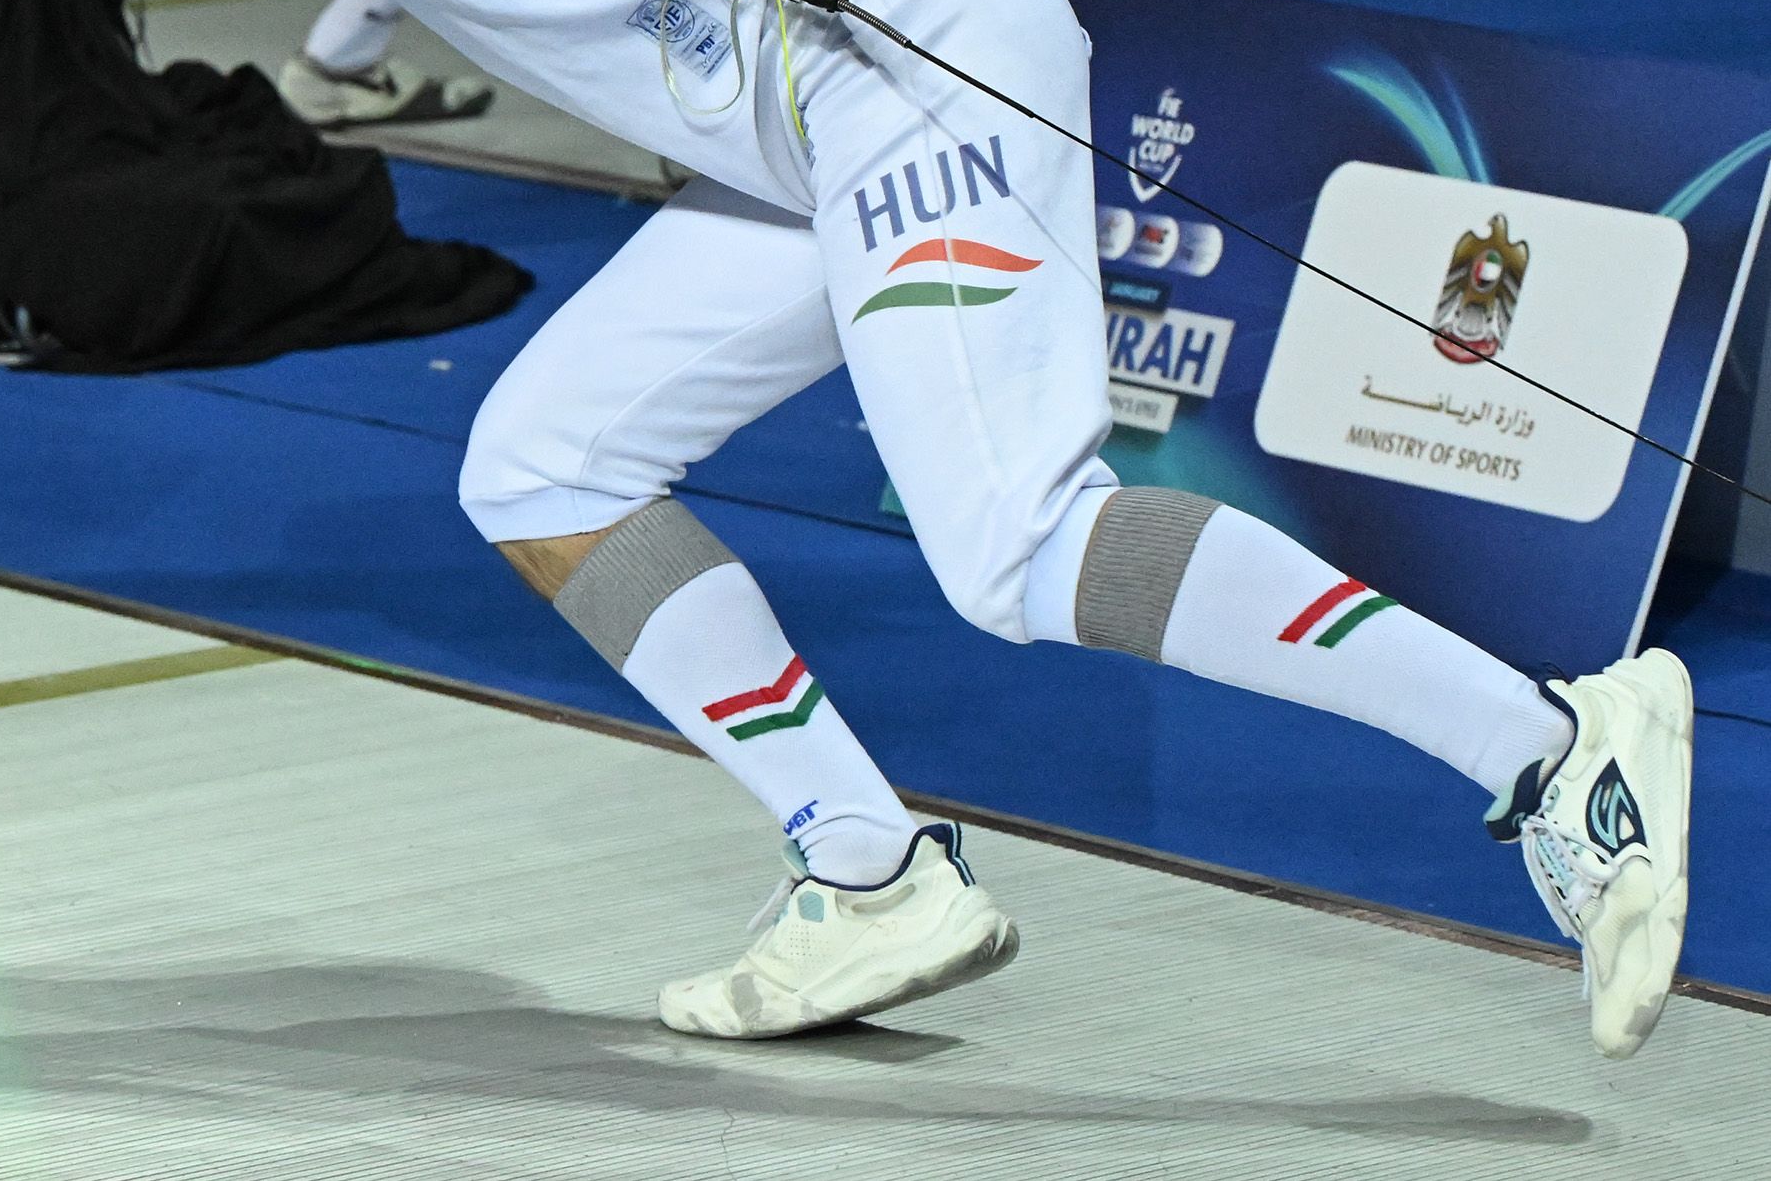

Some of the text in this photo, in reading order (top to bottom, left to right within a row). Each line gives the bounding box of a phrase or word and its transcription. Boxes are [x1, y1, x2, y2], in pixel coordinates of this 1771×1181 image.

[695, 34, 717, 55] PBT
[1131, 114, 1195, 145] WORLD
[1138, 139, 1176, 162] CUP
[854, 135, 1010, 253] HUN
[1494, 405, 1536, 439] وزارة
[1346, 425, 1523, 481] MINISTRY OF SPORTS
[783, 799, 819, 836] PBT
